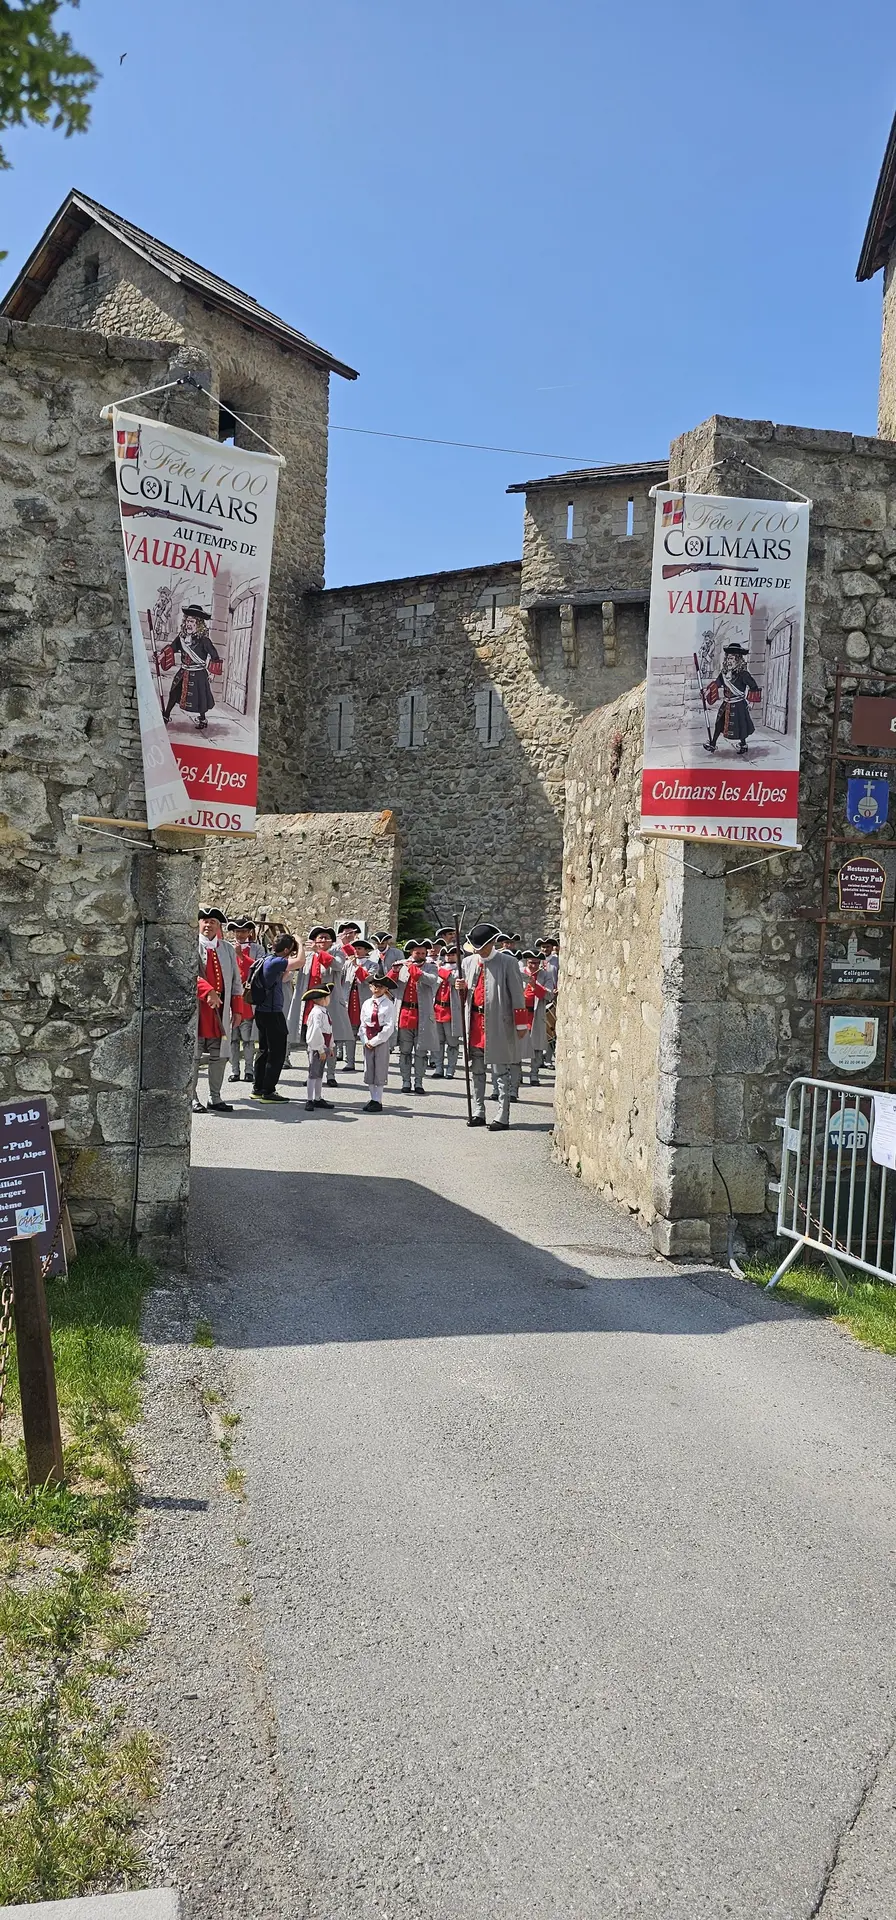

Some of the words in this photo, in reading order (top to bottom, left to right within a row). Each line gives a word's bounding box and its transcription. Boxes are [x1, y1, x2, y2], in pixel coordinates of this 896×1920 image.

[144, 440, 196, 479] Fête
[200, 463, 269, 497] 1700
[119, 464, 258, 525] COLMARS
[688, 502, 733, 532] Fête
[736, 510, 800, 534] 1700
[124, 530, 223, 578] VAUBAN
[173, 526, 196, 541] AU
[196, 531, 238, 552] TEMPS
[239, 542, 258, 557] DE
[663, 529, 791, 561] COLMARS
[714, 575, 734, 587] AU
[734, 576, 773, 588] TEMPS
[775, 578, 791, 589] DE
[667, 590, 759, 616] VAUBAN
[199, 763, 248, 791] Alpes
[851, 768, 888, 778] Mairie
[652, 779, 716, 801] Colmars
[718, 781, 741, 801] les
[742, 782, 788, 807] Alpes
[847, 865, 879, 873] Restaurant
[850, 874, 870, 883] Crazy
[870, 875, 884, 883] Pub
[3, 1109, 40, 1126] Pub
[22, 1150, 46, 1159] Alpes
